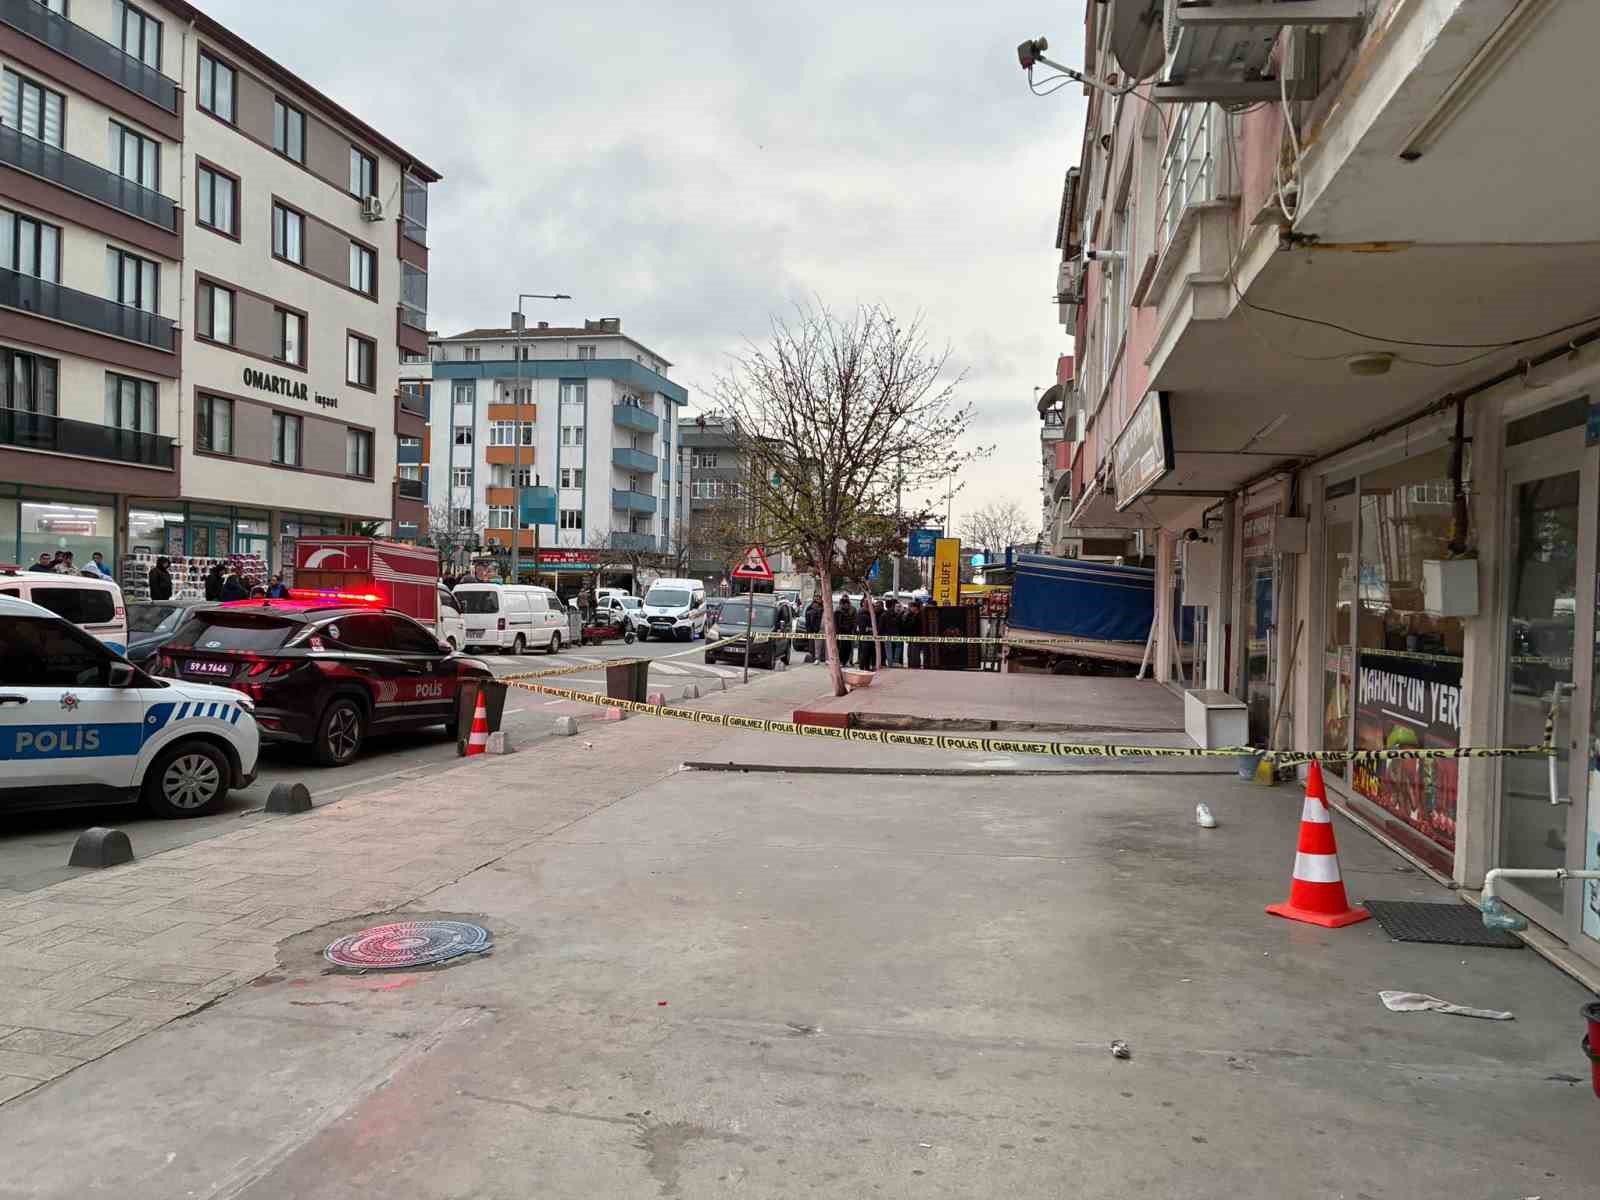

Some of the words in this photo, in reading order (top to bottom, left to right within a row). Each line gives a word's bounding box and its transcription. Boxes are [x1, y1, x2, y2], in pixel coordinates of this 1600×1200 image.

[243, 368, 308, 401] OMARTLAR
[1359, 666, 1425, 714] MAHMUT'UN
[15, 725, 100, 753] POLİS
